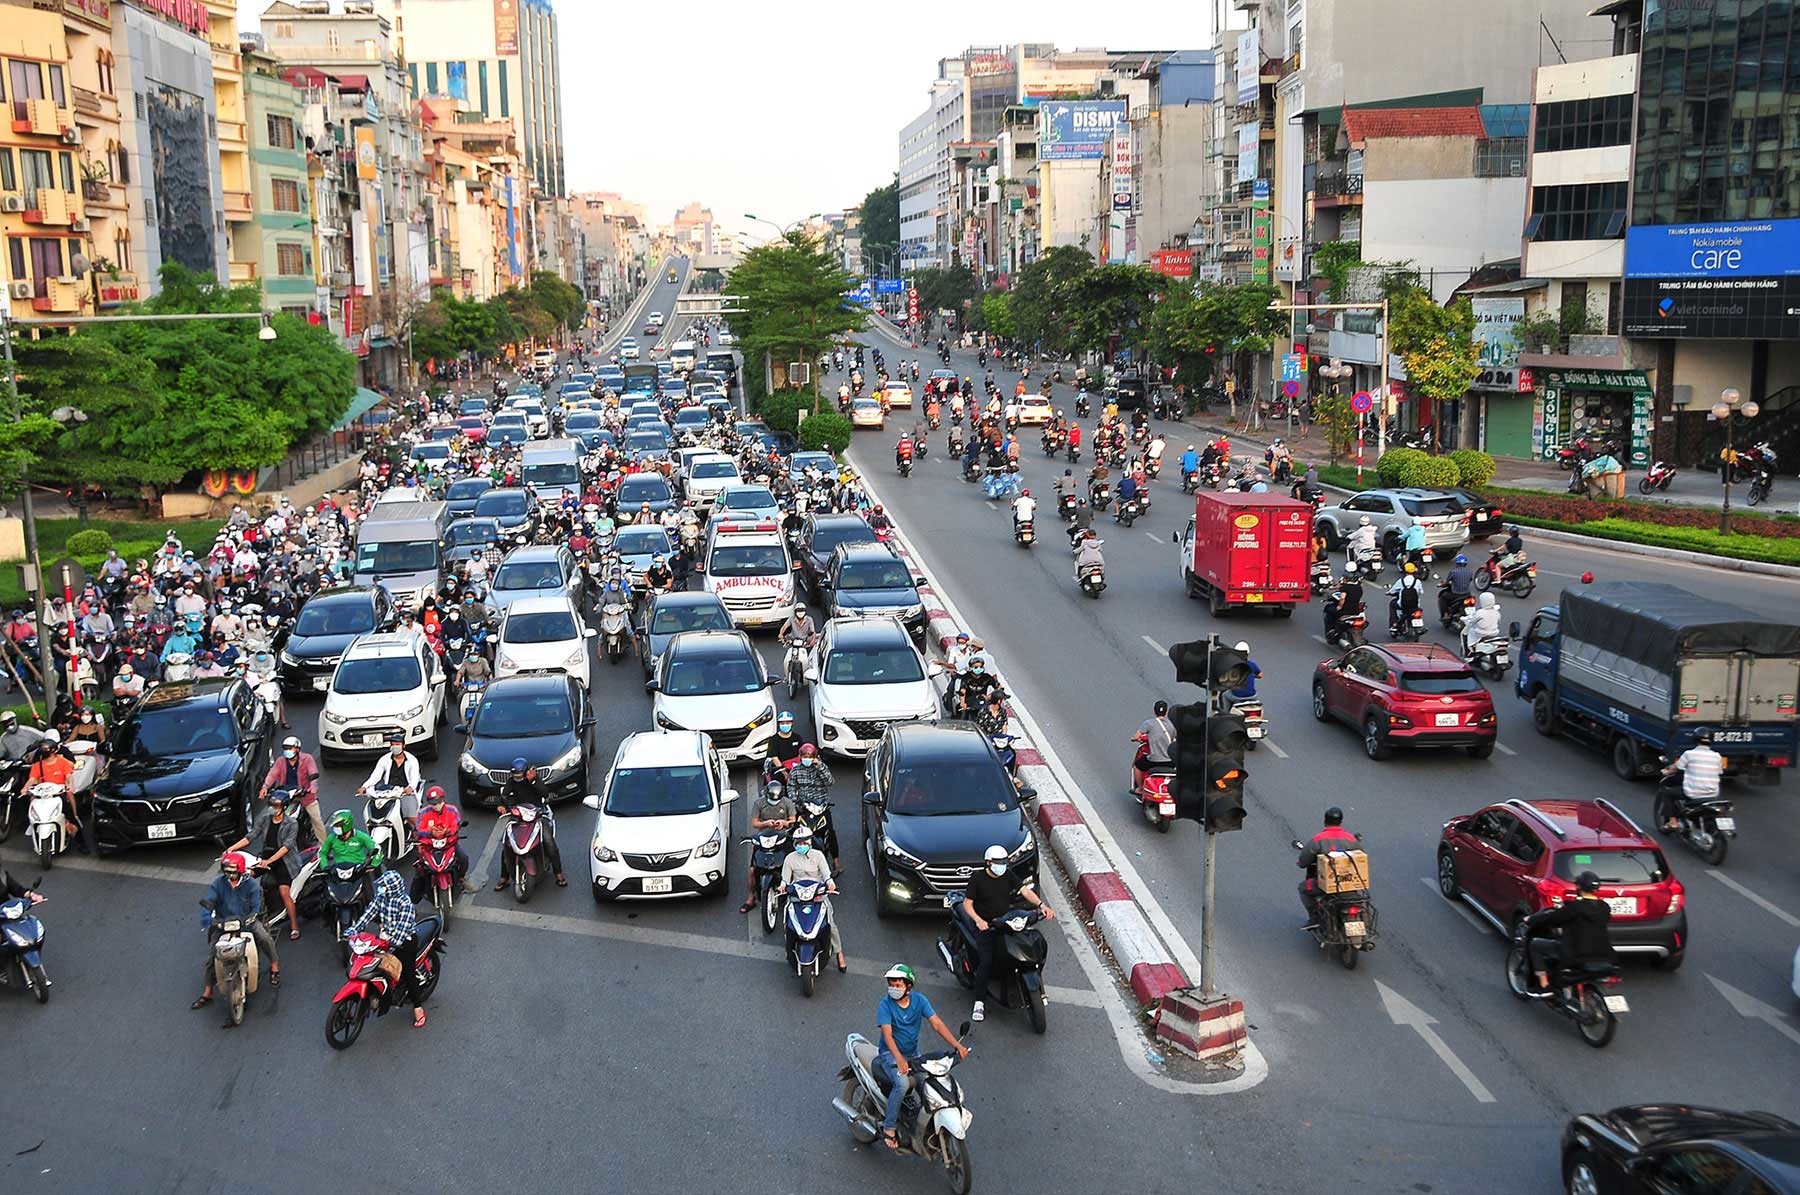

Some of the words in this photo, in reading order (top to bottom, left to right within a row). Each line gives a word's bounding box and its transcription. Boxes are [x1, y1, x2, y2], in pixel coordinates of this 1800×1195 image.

[1073, 111, 1119, 128] DISMY
[1693, 239, 1715, 247] Nokia
[1715, 237, 1743, 246] mobile
[1691, 249, 1742, 270] care
[1659, 282, 1681, 290] TRUNG
[1676, 303, 1744, 315] vietcomindo
[1606, 372, 1623, 385] MÁY
[1624, 373, 1647, 387] TÍNH
[716, 576, 784, 592] AMBULANCE
